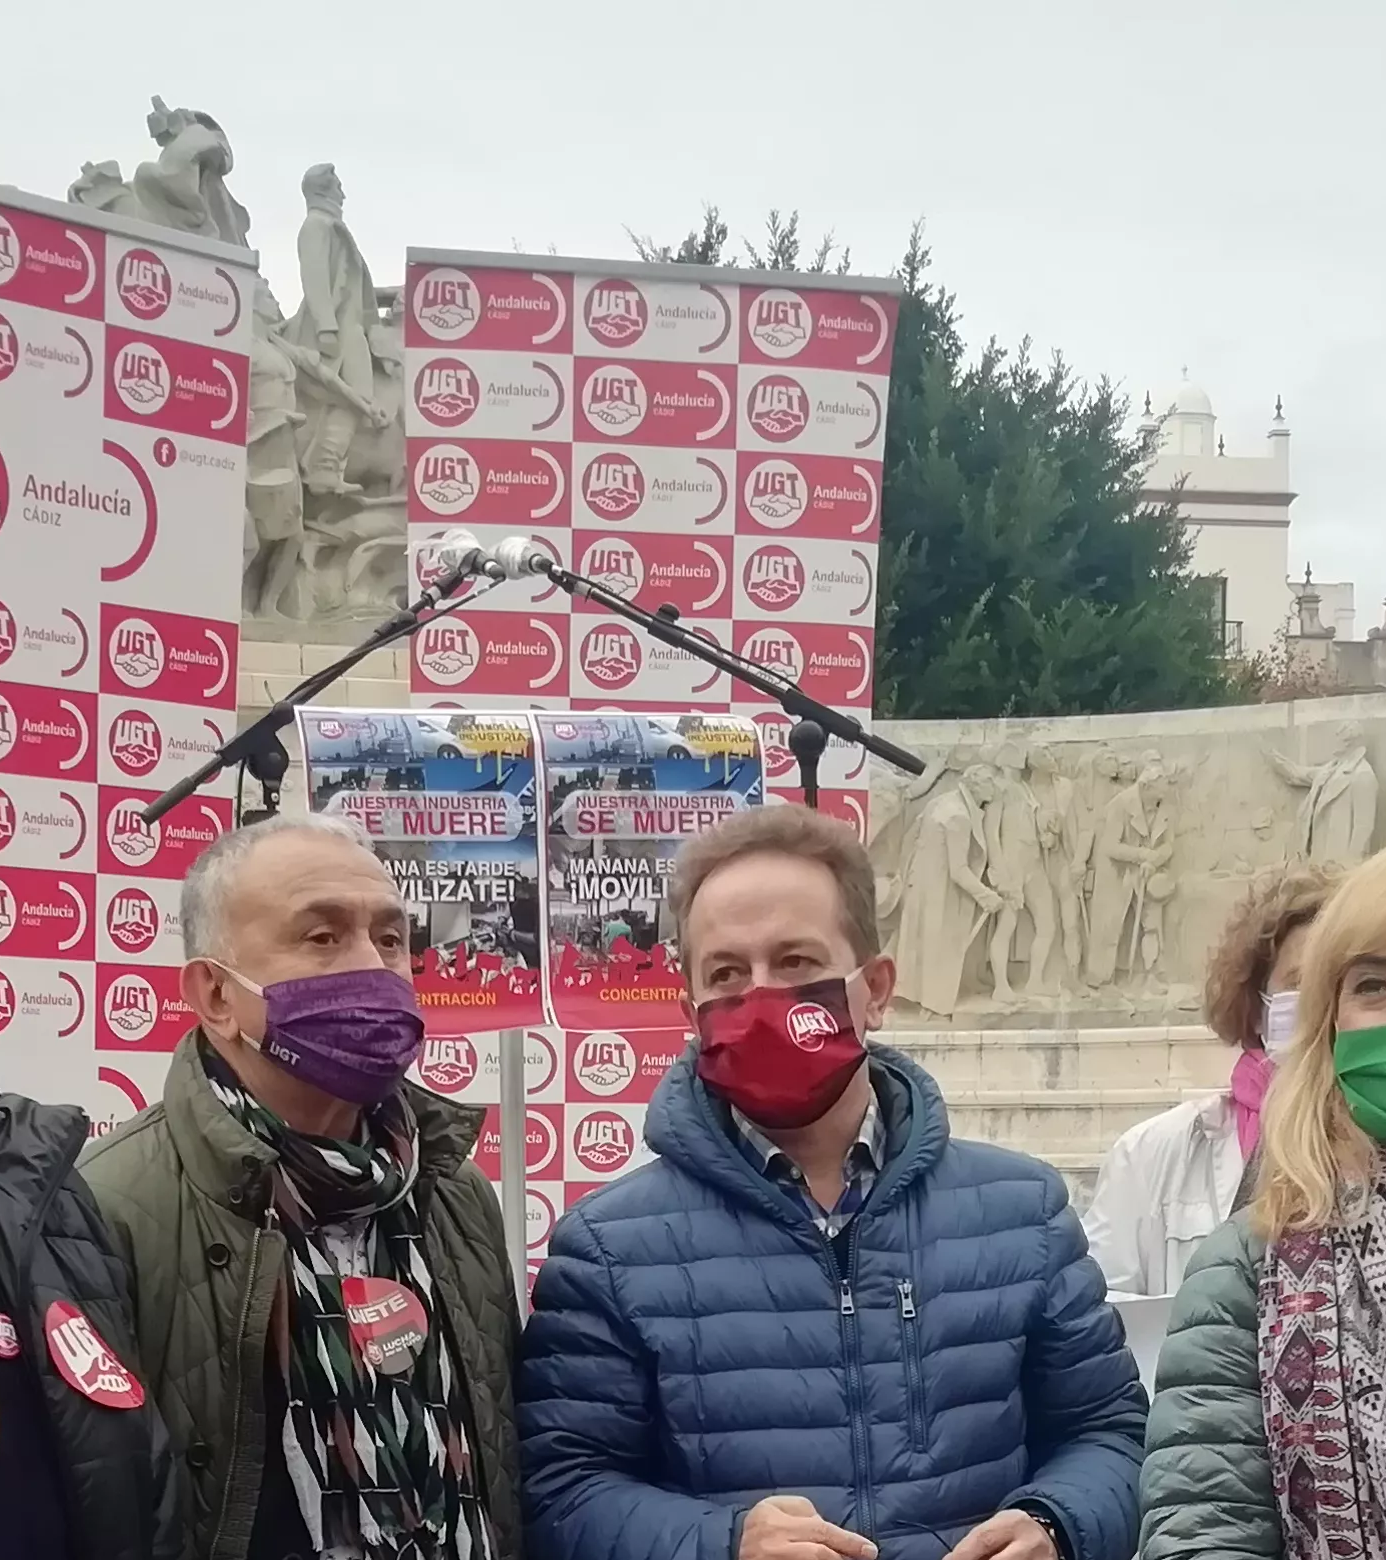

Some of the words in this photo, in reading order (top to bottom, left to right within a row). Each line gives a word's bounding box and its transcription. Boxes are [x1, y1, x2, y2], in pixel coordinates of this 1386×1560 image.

[121, 258, 166, 295] UGT
[423, 280, 470, 307] UGT
[592, 290, 638, 318] UGT
[757, 299, 802, 326] UGT
[121, 352, 163, 387] UGT
[421, 369, 471, 396] UGT
[591, 377, 638, 403] UGT
[754, 385, 802, 414] UGT
[423, 457, 470, 484] UGT
[589, 464, 637, 490] UGT
[22, 474, 131, 517] Andalucía
[754, 471, 798, 498] UGT
[23, 505, 62, 527] CÁDIZ
[588, 549, 635, 576] UGT
[752, 555, 797, 582] UGT
[117, 629, 157, 661] UGT
[424, 628, 469, 656] UGT
[586, 633, 634, 661] UGT
[749, 640, 795, 667] UGT
[115, 720, 156, 755] UGT
[341, 796, 417, 810] NUESTRA
[422, 796, 508, 811] INDUSTRIA
[576, 796, 648, 809] NUESTRA
[653, 796, 735, 809] INDUSTRIA
[402, 811, 508, 836] MUERE
[577, 811, 616, 834] SE
[425, 860, 450, 877] ES
[454, 860, 515, 877] TARDE
[569, 856, 650, 874] MAÑANA
[655, 859, 677, 874] ES
[113, 898, 153, 930] UGT
[112, 986, 150, 1014] UGT
[792, 1012, 832, 1035] UGT
[269, 1040, 301, 1066] UGT
[425, 1040, 470, 1067] UGT
[581, 1043, 627, 1067] UGT
[581, 1121, 626, 1146] UGT
[383, 1331, 416, 1351] LUCHA
